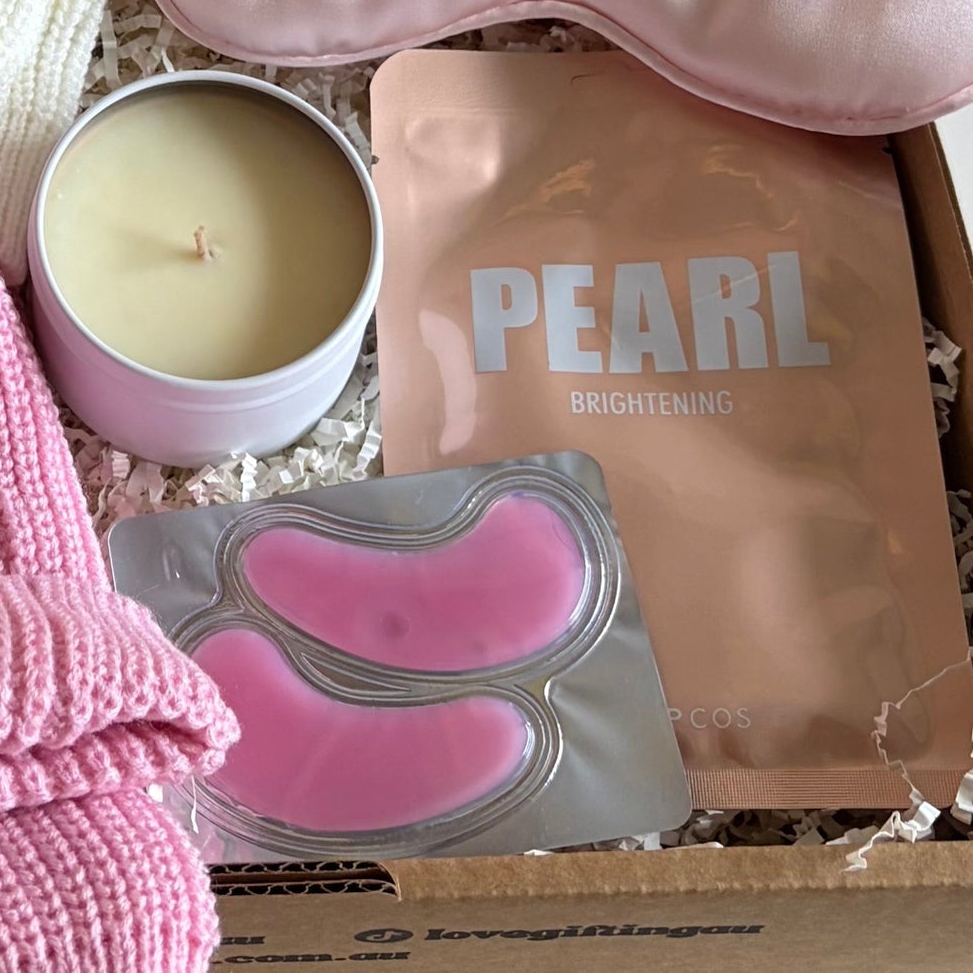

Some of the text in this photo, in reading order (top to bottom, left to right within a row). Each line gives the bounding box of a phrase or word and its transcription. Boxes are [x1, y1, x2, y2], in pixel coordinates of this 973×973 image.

[470, 250, 832, 374] PEARL
[570, 390, 733, 415] BRIGHTENING
[423, 924, 765, 941] lovegiftingau
